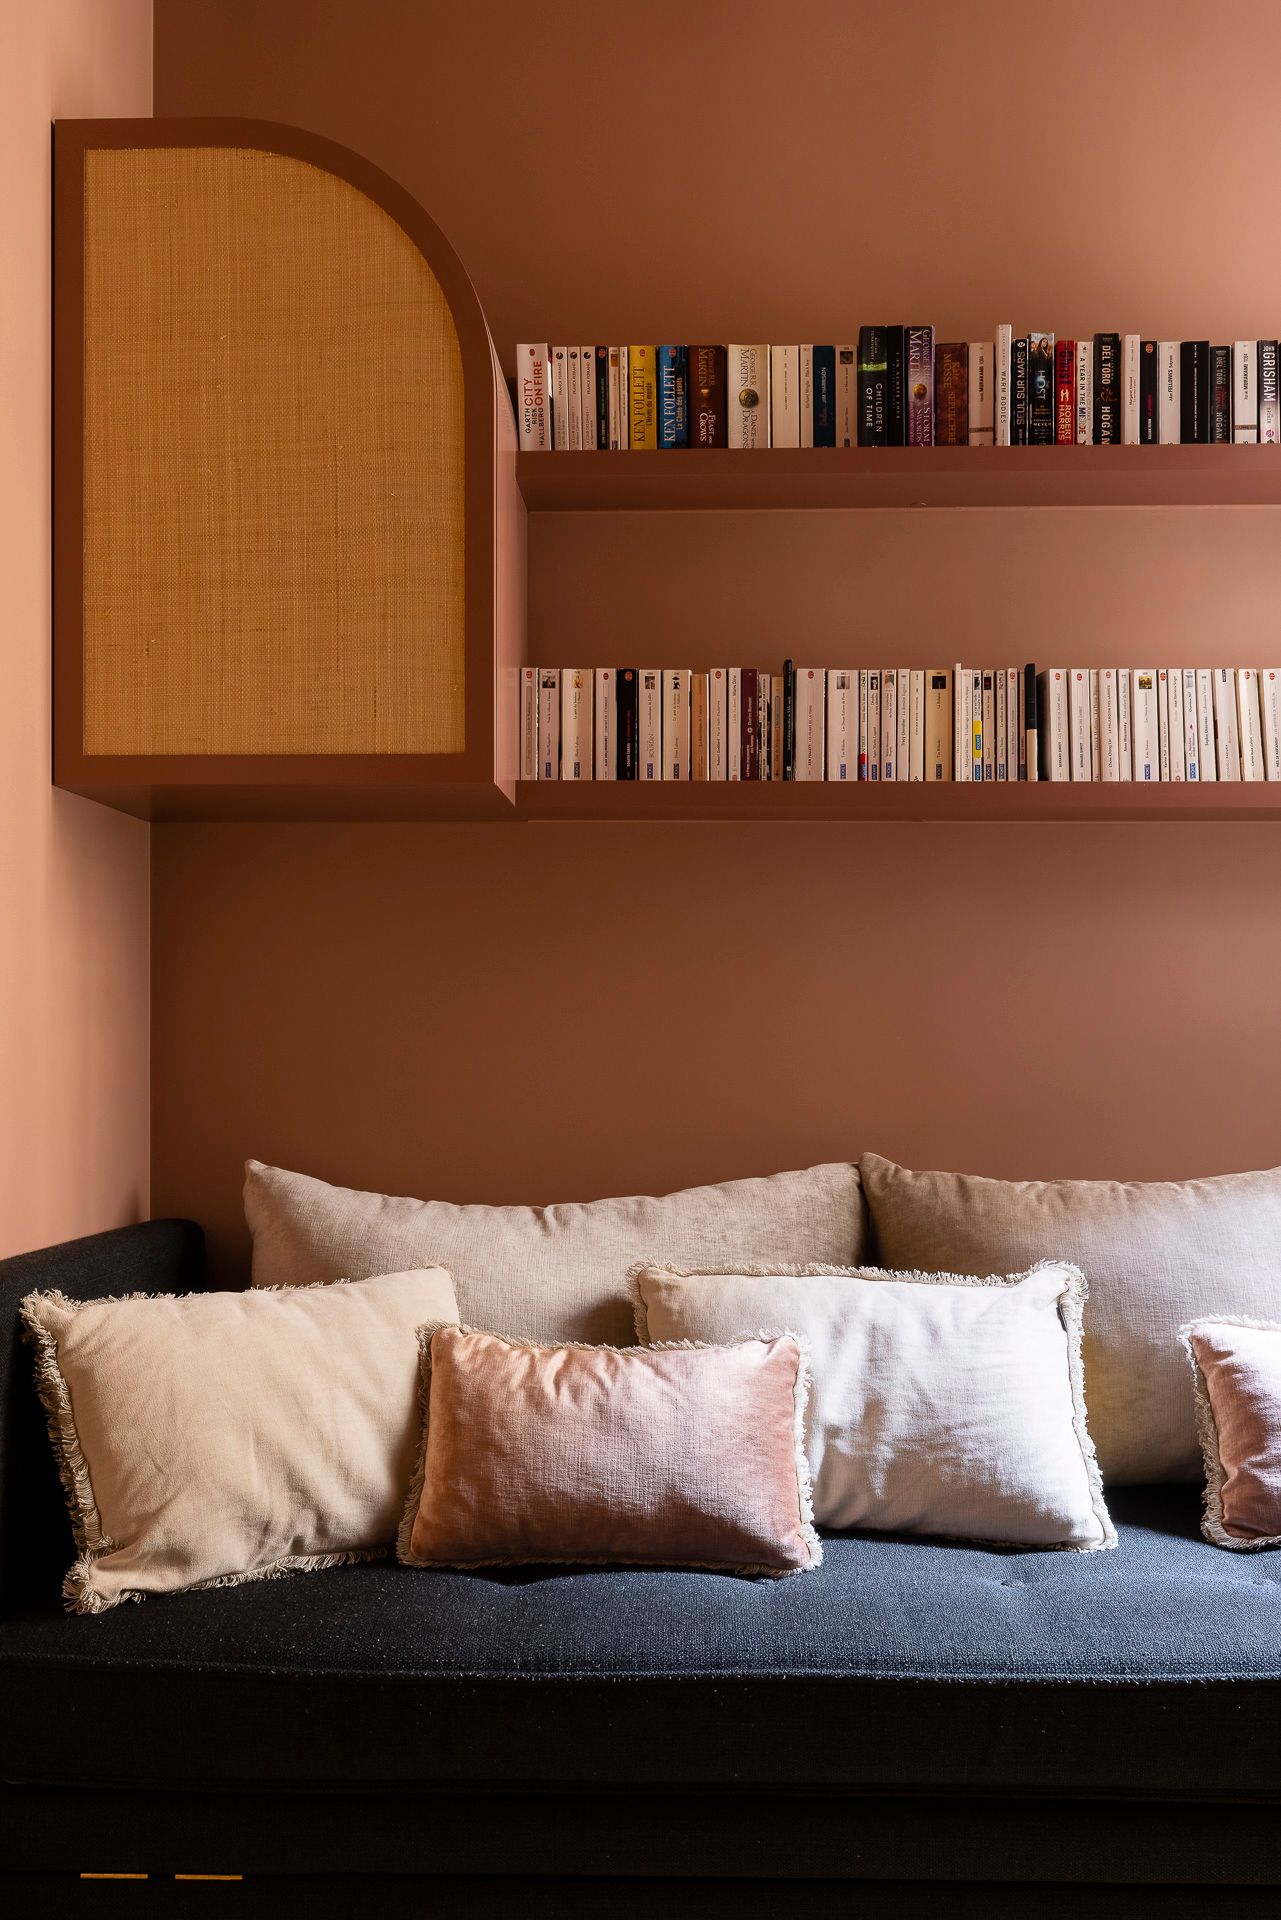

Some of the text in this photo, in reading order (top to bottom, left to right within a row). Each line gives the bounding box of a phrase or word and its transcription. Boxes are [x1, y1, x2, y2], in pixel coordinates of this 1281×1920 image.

[909, 330, 922, 382] MARTIN
[923, 329, 931, 364] GEORGE
[698, 348, 708, 387] MARTIN
[740, 348, 750, 387] MARTIN
[943, 353, 951, 389] MOSSE
[952, 362, 960, 379] Kate
[1016, 351, 1025, 378] MARS
[1059, 350, 1074, 385] Ghost
[1101, 345, 1110, 384] DEL TORO
[1263, 352, 1276, 402] GRISHAM
[524, 378, 533, 406] CITY
[533, 361, 543, 406] ON FIRE
[676, 377, 684, 395] géants
[866, 387, 872, 400] OF
[1016, 380, 1025, 399] SUR
[1036, 370, 1046, 400] HOST
[633, 366, 645, 442] KEN FOLLETT
[663, 365, 676, 442] KEN FOLLETT
[948, 391, 956, 443] SEPULCHRE
[1016, 401, 1025, 425] SEUL
[699, 412, 708, 441] CROWS
[708, 415, 716, 435] FEAST
[742, 410, 750, 448] DRAGONS
[1101, 406, 1110, 445] HOGAN
